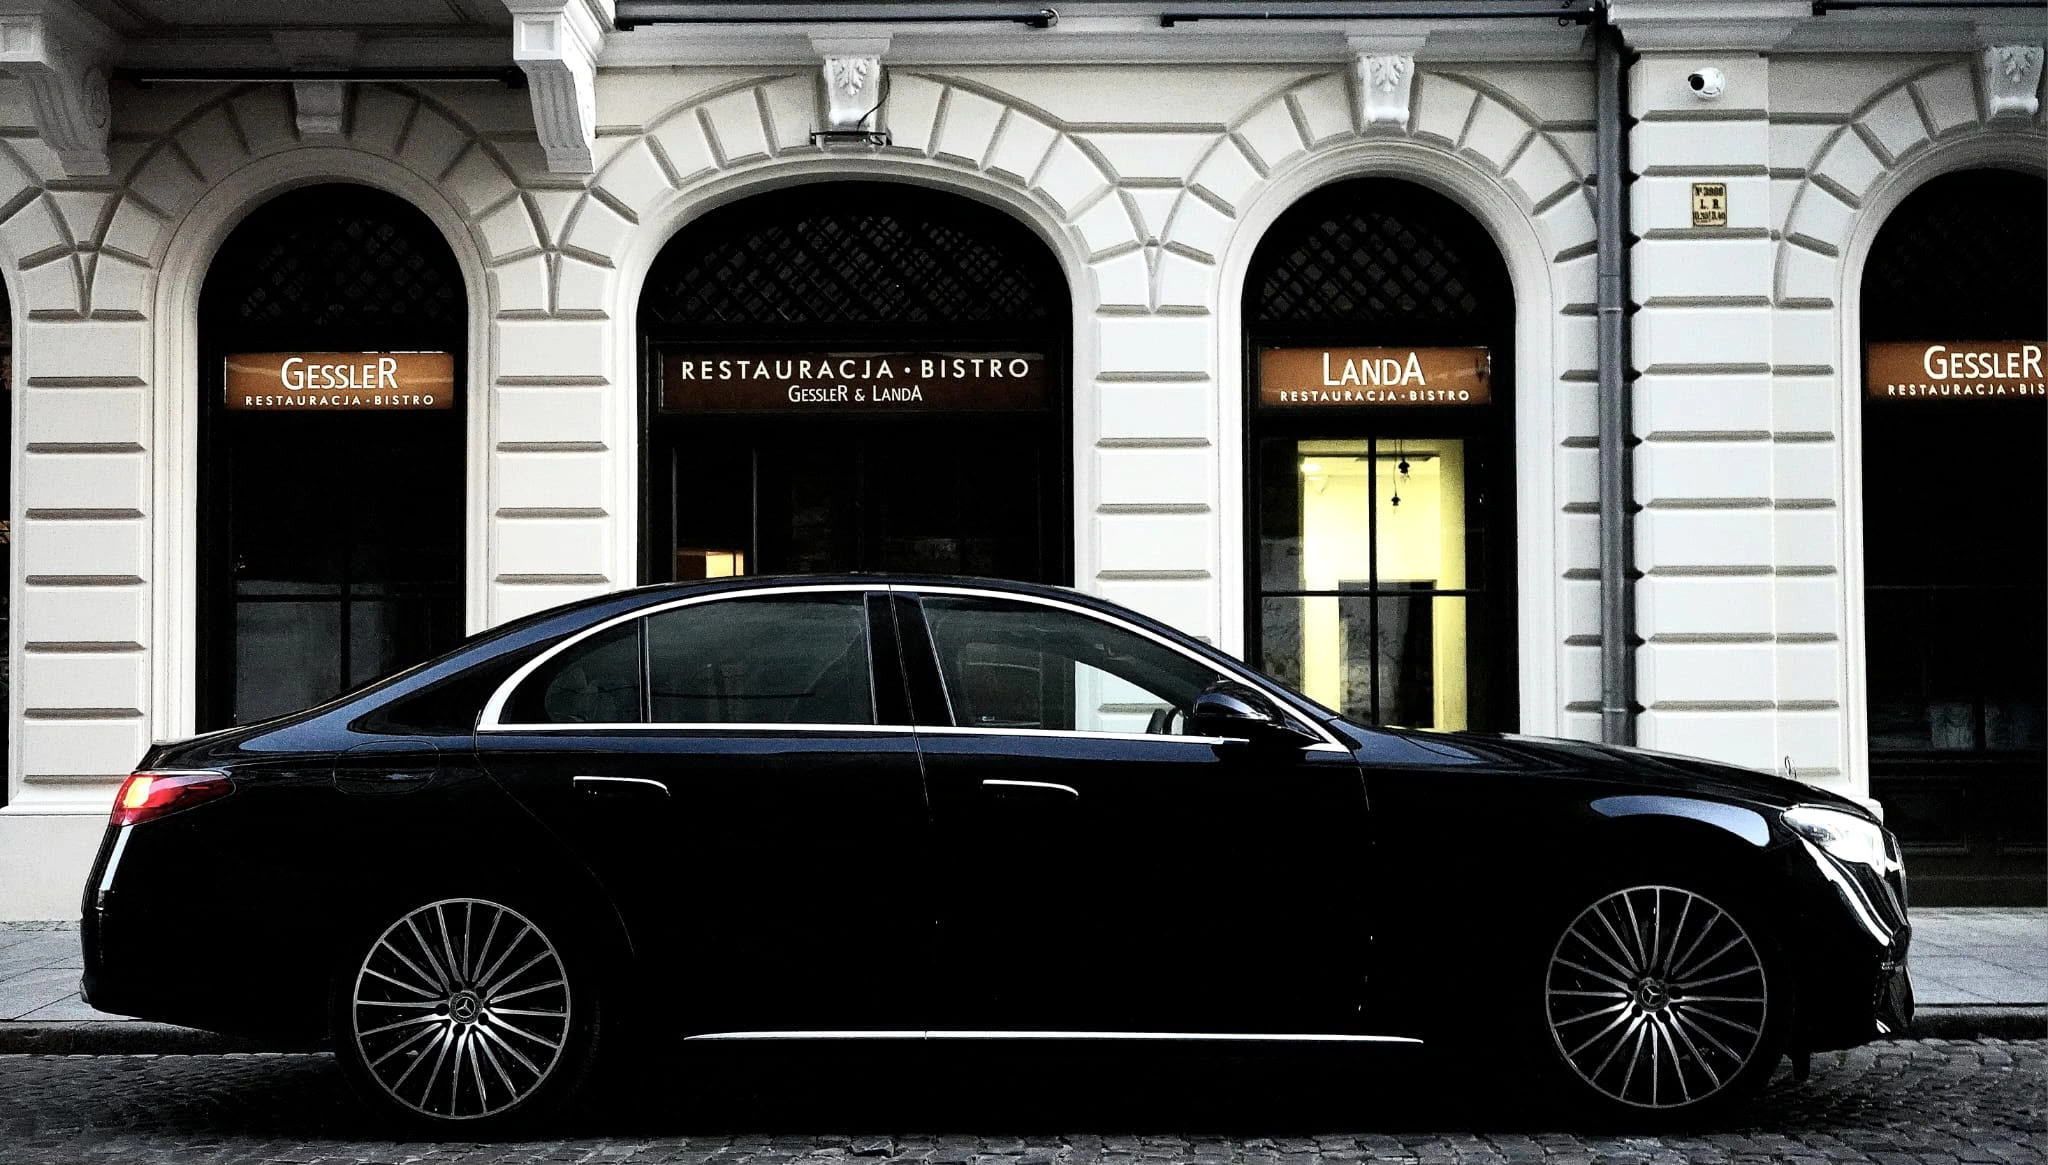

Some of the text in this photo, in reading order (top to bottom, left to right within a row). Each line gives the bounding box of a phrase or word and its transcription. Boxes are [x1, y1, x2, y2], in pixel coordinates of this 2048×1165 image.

[682, 358, 1030, 380] RESTAURACJA BISTRO
[1322, 351, 1426, 387] LANDA
[1923, 345, 2044, 380] GESSLER
[280, 356, 399, 391] GESSLER
[788, 384, 923, 403] GESSLER & LANDA
[1280, 389, 1470, 403] RESTAURACJA BISTRO
[1887, 383, 2007, 396] RESTAURACJA
[245, 394, 434, 407] RESTAURACJA BISTRO
